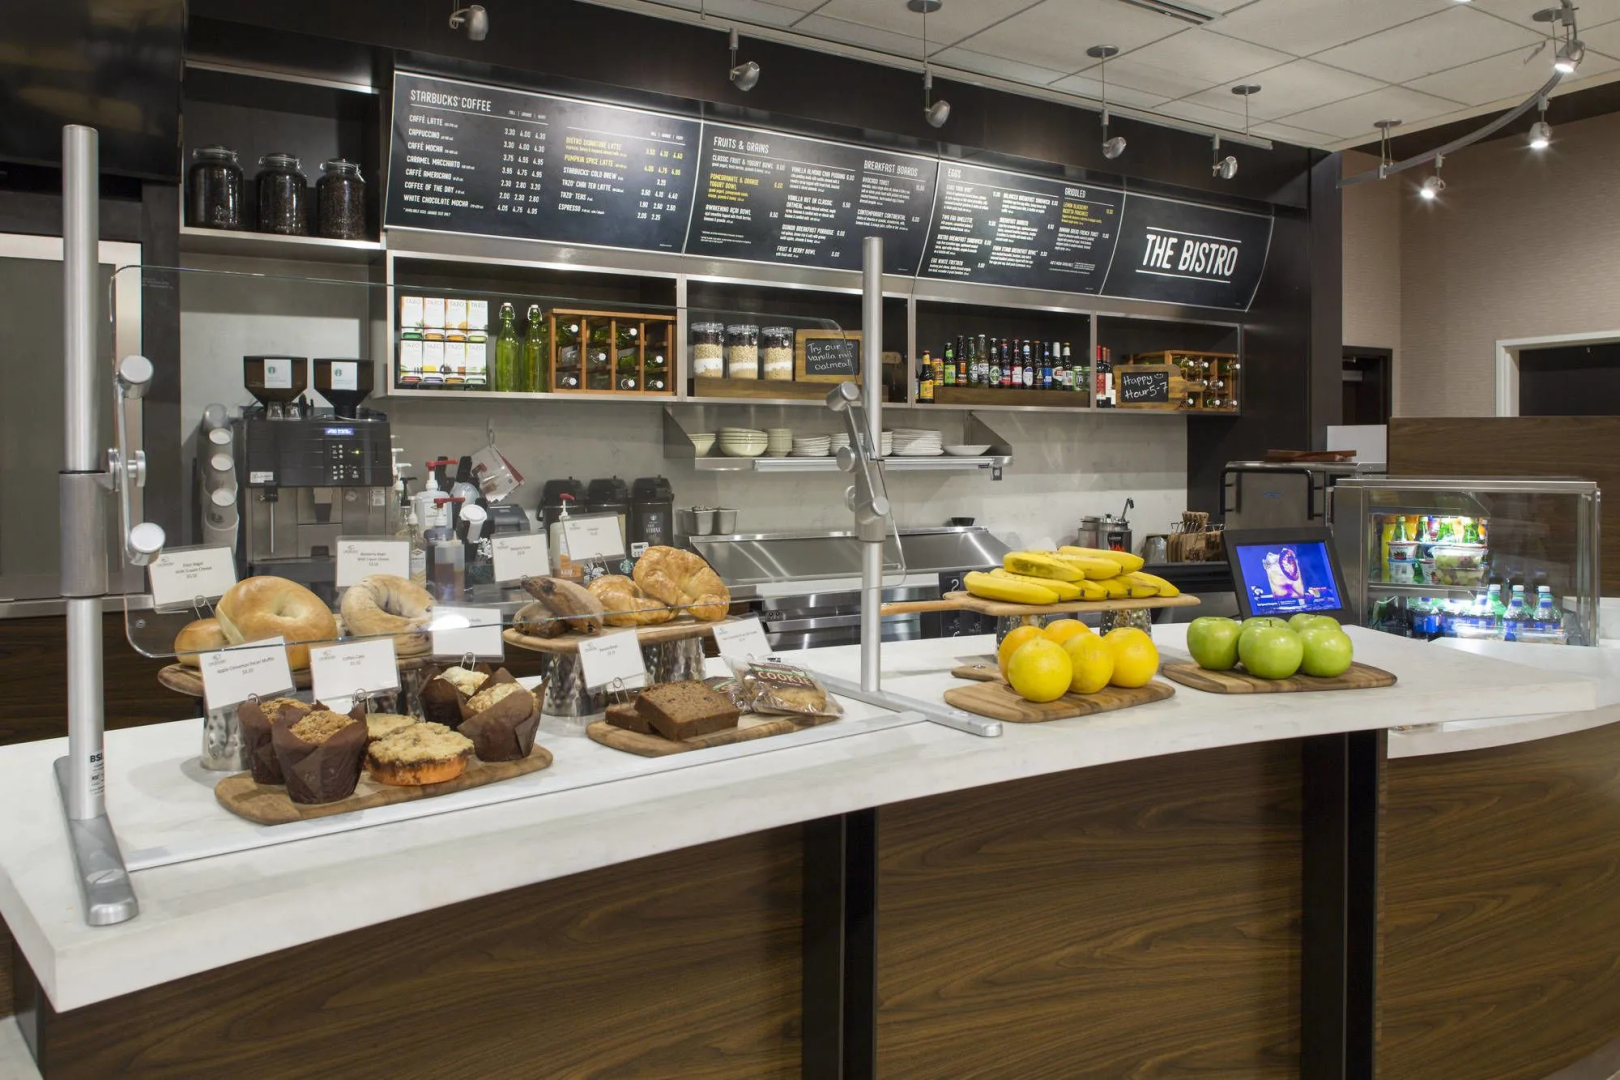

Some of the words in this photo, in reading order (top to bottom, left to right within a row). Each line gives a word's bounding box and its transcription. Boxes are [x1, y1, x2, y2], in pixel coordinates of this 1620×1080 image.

[410, 90, 458, 106] STARBUCKS
[462, 98, 492, 112] COFFEE
[427, 118, 443, 126] LATTE
[408, 128, 440, 138] CAPPUCCINO
[714, 136, 736, 148] FRUITS
[739, 140, 744, 150] &
[747, 142, 769, 154] GRAINS
[407, 155, 430, 164] CARAMEL
[864, 160, 896, 173] BREAKFAST
[897, 166, 918, 176] BOARDS
[423, 171, 452, 180] AMERICANO
[405, 182, 423, 190] COFFEE
[1065, 188, 1086, 198] GRIDDLED
[422, 197, 449, 205] CHOCOLATE
[559, 203, 581, 212] ESPRESSO
[1143, 234, 1178, 269] THE
[1178, 240, 1238, 276] BISTRO
[807, 342, 821, 354] Try
[808, 352, 836, 361] vanilla
[839, 350, 852, 358] nut
[814, 359, 852, 370] oatmeal
[1123, 376, 1153, 386] Happy
[1125, 389, 1149, 399] Hour
[1150, 382, 1167, 396] 5-7
[951, 578, 959, 592] 2
